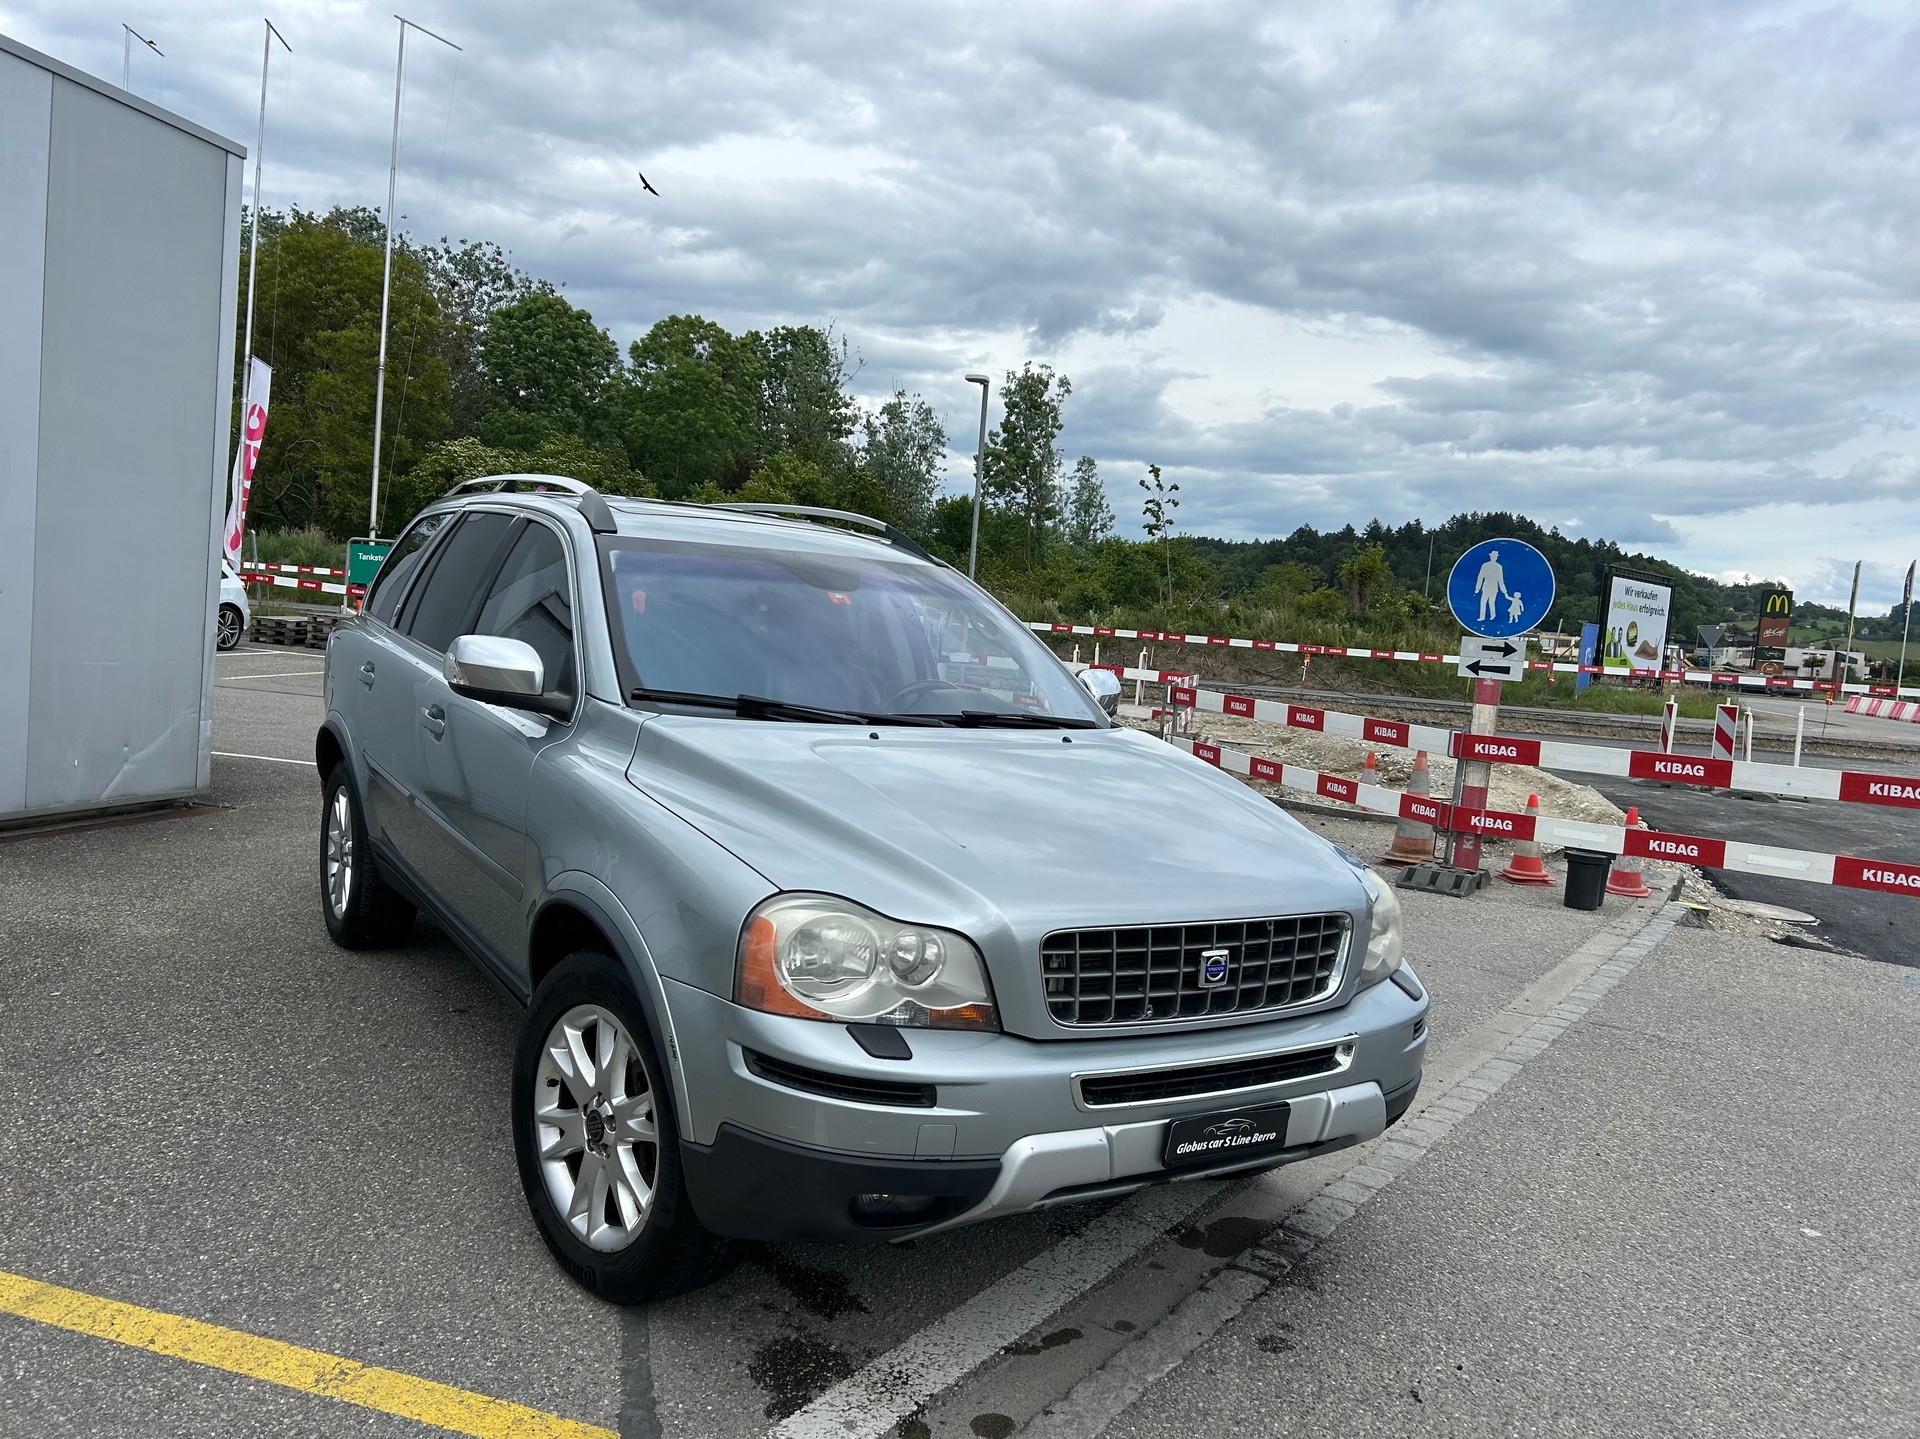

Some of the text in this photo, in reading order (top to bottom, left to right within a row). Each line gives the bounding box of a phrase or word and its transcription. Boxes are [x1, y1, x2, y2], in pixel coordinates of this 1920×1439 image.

[1624, 585, 1658, 601] Wir verkaufen
[1612, 598, 1666, 617] jedes Haus erfolgreich.
[1176, 692, 1190, 701] KIBAG
[1230, 701, 1247, 712] KIBAG
[1295, 712, 1315, 724] KIBAG
[1374, 726, 1397, 739] KIBAG
[1199, 749, 1214, 760] KIBAG
[1474, 743, 1517, 757] KIBAG
[1256, 763, 1274, 776] KIBAG
[1654, 761, 1705, 777] KIBAG
[1326, 781, 1347, 795] KIBAG
[1411, 803, 1436, 818] KIBAG
[1470, 815, 1513, 831] KIBAG
[1649, 839, 1699, 857] KIBAG
[1862, 868, 1920, 889] KIBAG
[1176, 1132, 1277, 1155] Globus car S Line Berro
